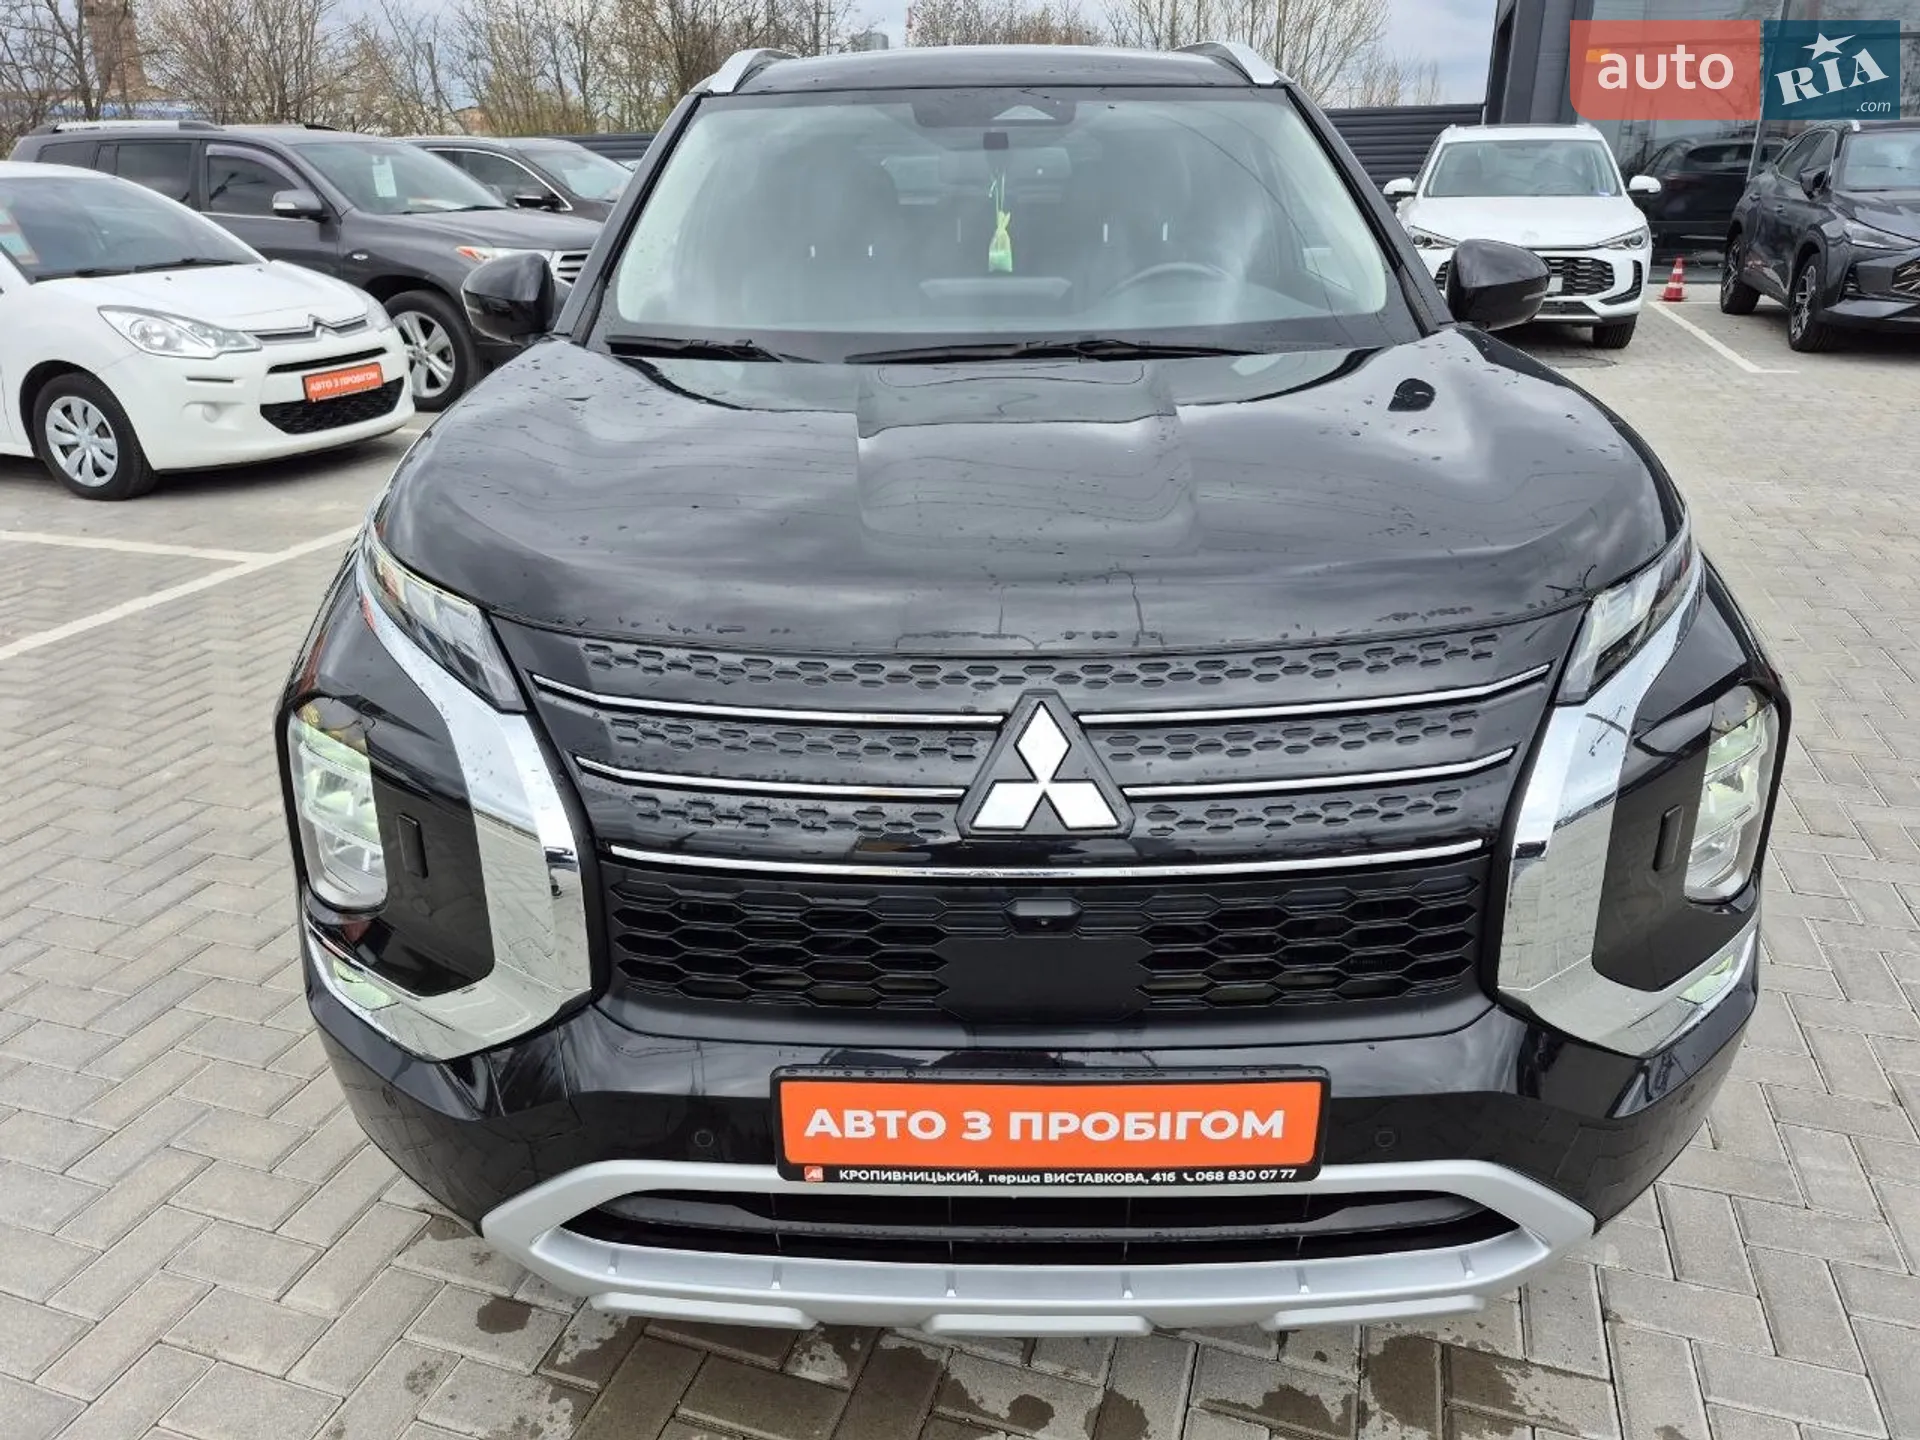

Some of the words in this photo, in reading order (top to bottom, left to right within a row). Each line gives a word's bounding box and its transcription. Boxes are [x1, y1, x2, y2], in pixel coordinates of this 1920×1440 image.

[804, 1108, 946, 1139] АВТО
[1008, 1110, 1285, 1141] ПРОБІГОМ
[839, 1169, 983, 1184] КРОПИВНИЦЬКИЙ,
[988, 1174, 1040, 1184] перша
[1044, 1173, 1149, 1184] ВИСТАВКОВА,
[1227, 1170, 1257, 1181] 830
[1259, 1170, 1277, 1180] 07
[1280, 1169, 1297, 1179] 77
